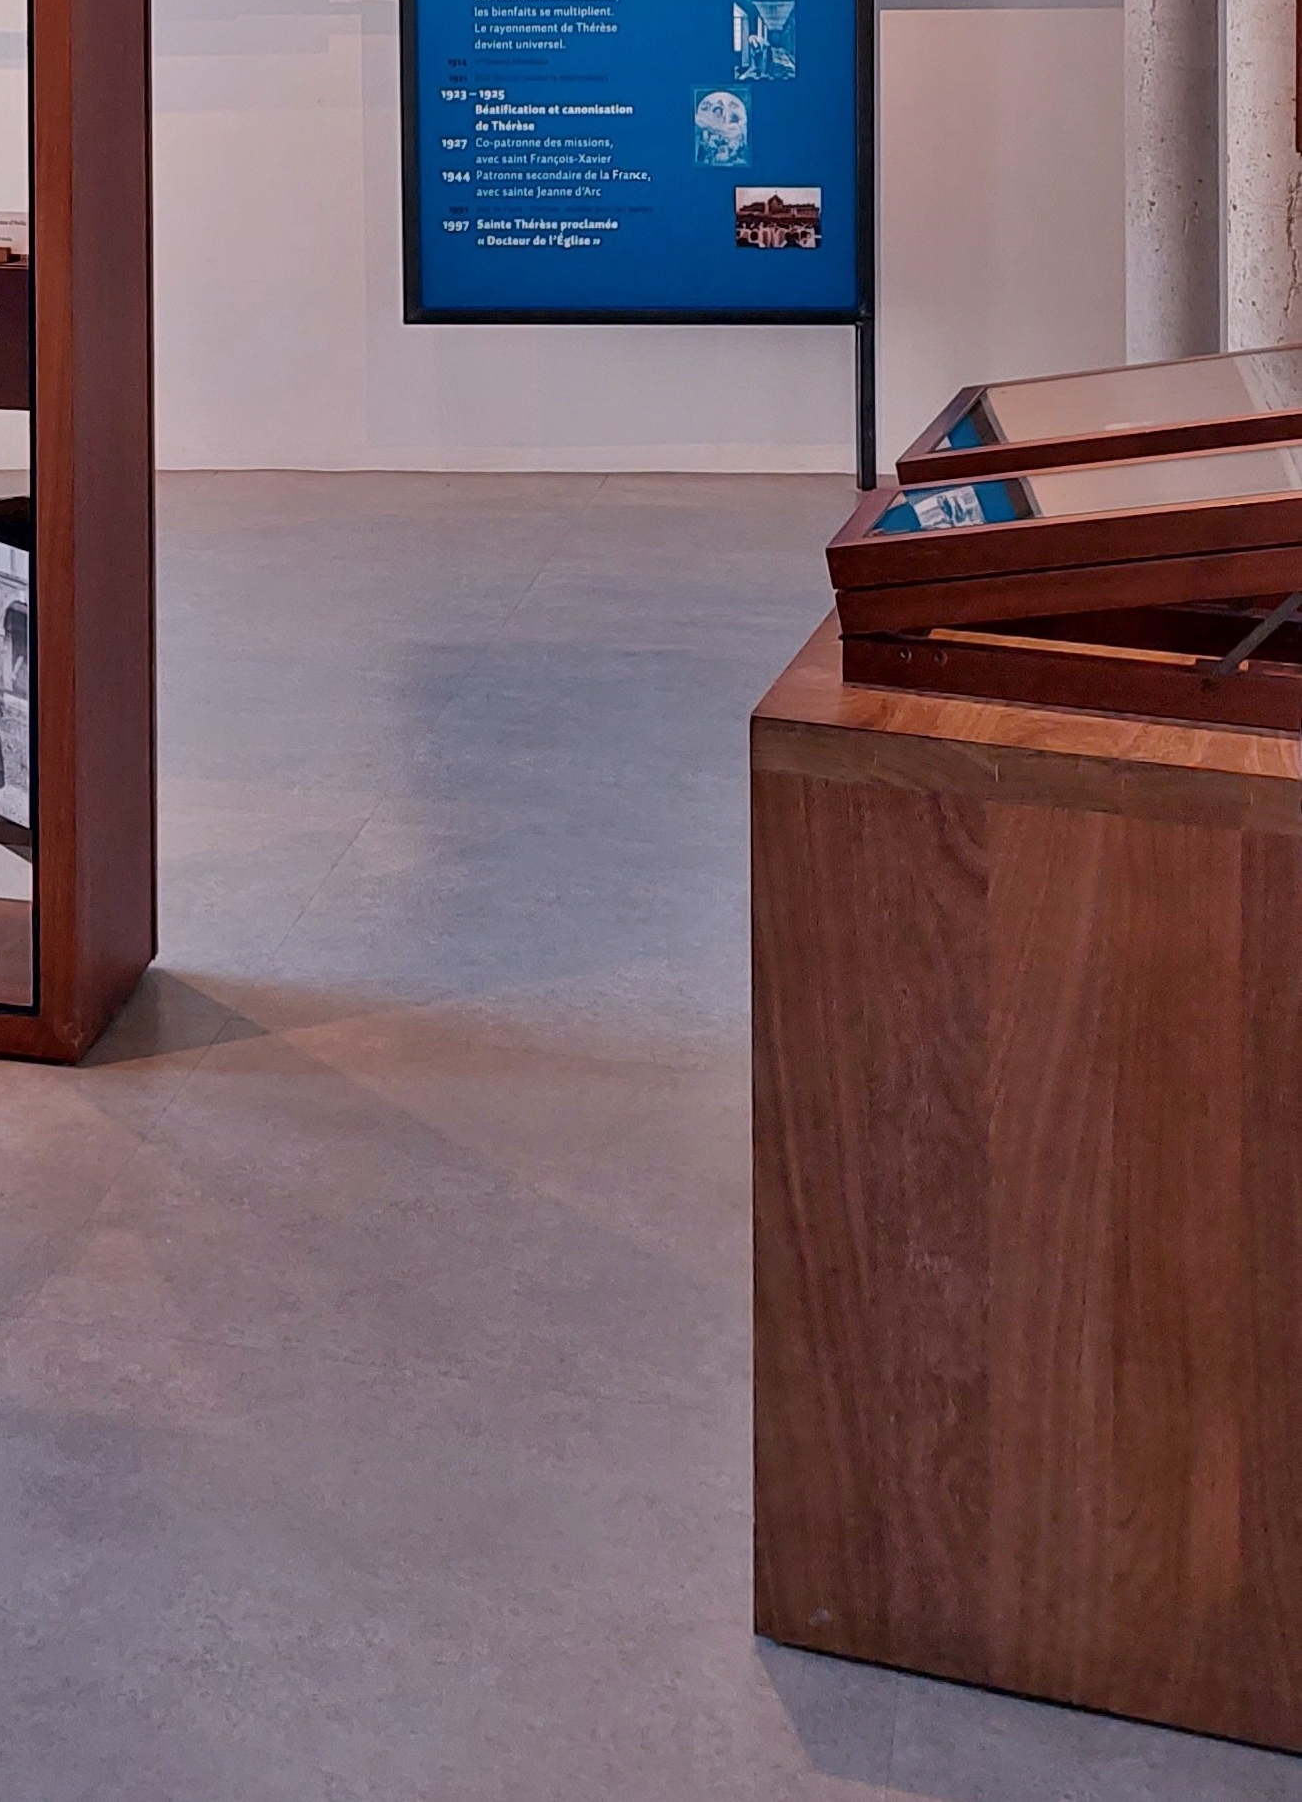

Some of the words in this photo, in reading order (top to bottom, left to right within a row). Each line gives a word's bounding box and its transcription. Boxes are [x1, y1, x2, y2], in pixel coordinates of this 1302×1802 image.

[440, 89, 467, 101] 1923
[478, 89, 505, 100] 1925
[475, 103, 546, 115] Béatification
[547, 104, 560, 114] et
[561, 103, 633, 114] canonisation
[474, 120, 489, 131] de
[490, 120, 535, 131] Thérèse
[442, 220, 469, 231] 1997
[476, 219, 512, 229] Sainte
[513, 218, 558, 229] Thérèse
[559, 218, 618, 232] proclamée
[486, 234, 531, 245] Docteur
[532, 234, 546, 245] de
